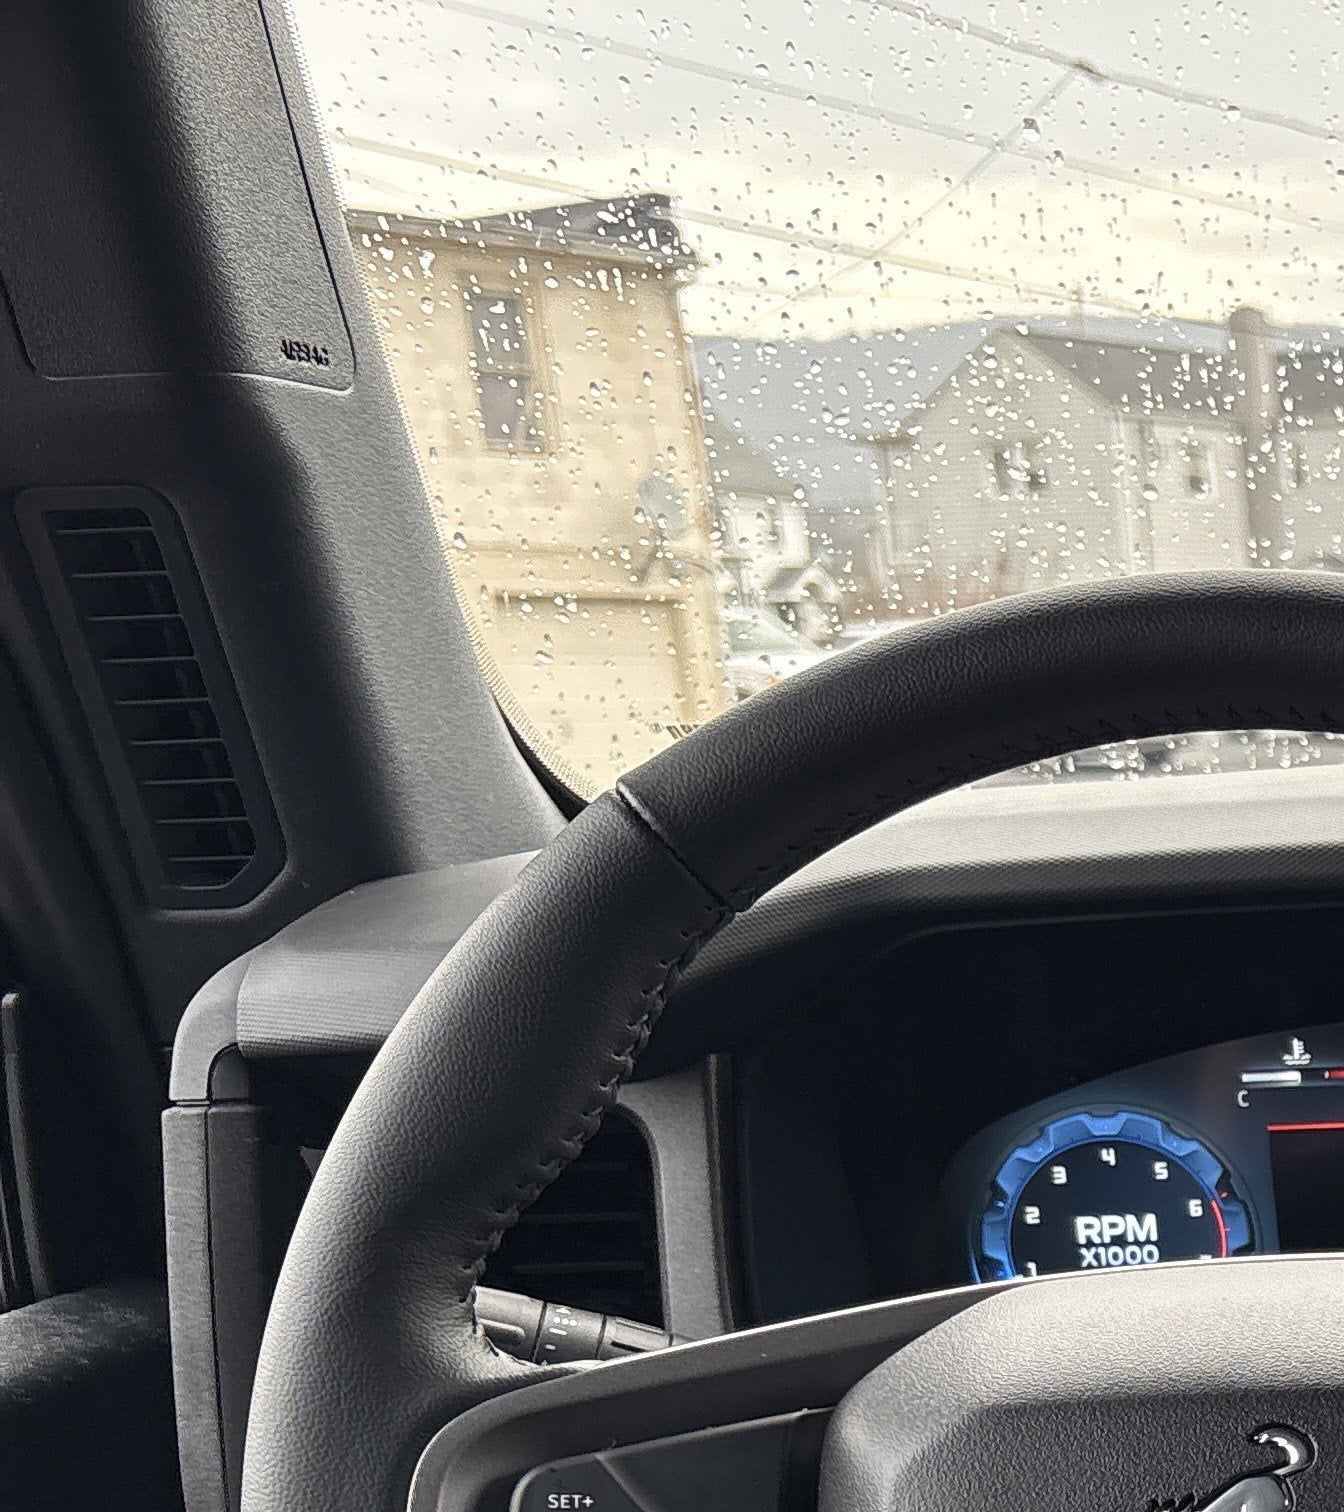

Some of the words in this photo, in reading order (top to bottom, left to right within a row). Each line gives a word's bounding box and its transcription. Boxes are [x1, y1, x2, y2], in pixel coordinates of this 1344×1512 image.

[1237, 1090, 1250, 1108] C
[1100, 1148, 1116, 1167] 4
[1051, 1165, 1068, 1185] 3
[1153, 1161, 1169, 1180] 5
[1024, 1206, 1041, 1225] 2
[1188, 1199, 1203, 1218] 6
[1075, 1213, 1158, 1245] RPM
[1079, 1245, 1160, 1268] X1000
[548, 1494, 594, 1510] SET+
